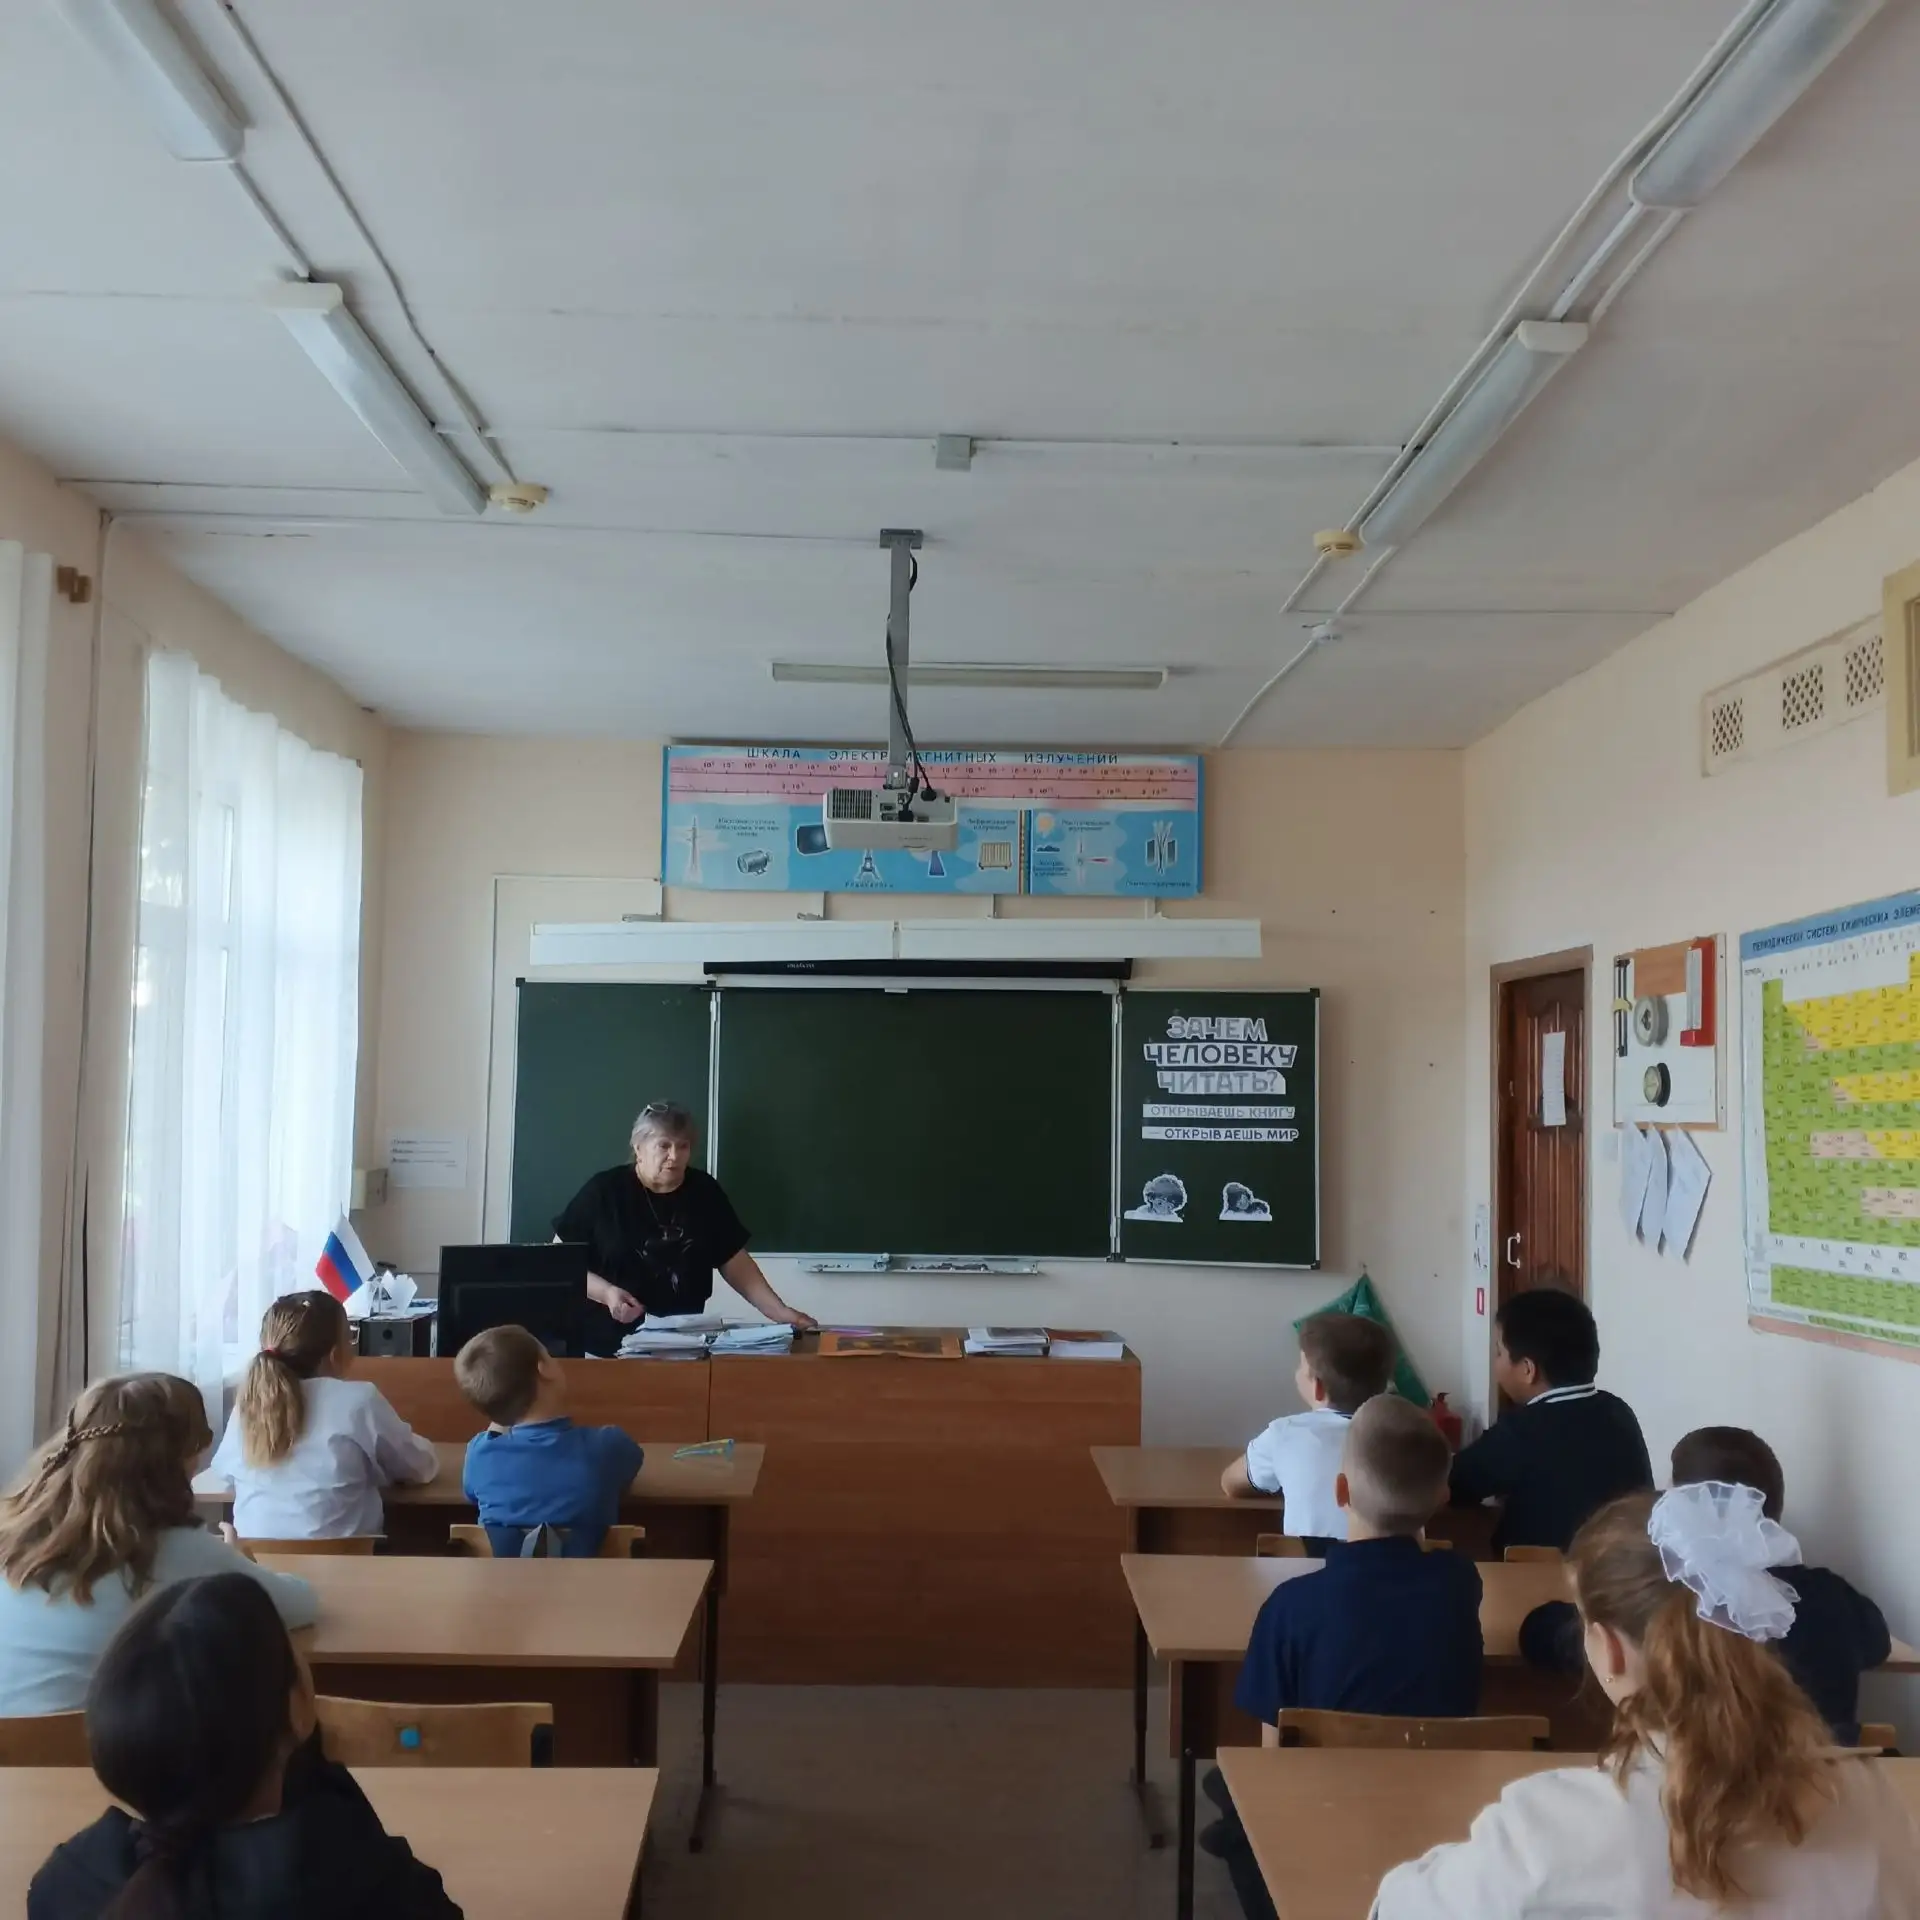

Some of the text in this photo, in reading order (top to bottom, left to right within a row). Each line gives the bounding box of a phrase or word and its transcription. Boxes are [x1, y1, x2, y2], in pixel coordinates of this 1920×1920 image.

[747, 748, 800, 759] ШКАЛА
[829, 750, 997, 763] ЭЛЕКТРМАГНИТНЫХ
[1167, 1016, 1268, 1041] ЗАЧЕМ
[1145, 1044, 1296, 1066] ЧЕЛОВЕКУ
[1159, 1071, 1279, 1093] ЧИТАТЬ?
[1150, 1105, 1295, 1119] ОТКРЫВАЕШЬ КНИГУ
[1164, 1128, 1263, 1140] ОТКРЫВАЕШЬ
[1266, 1129, 1299, 1140] МИР
